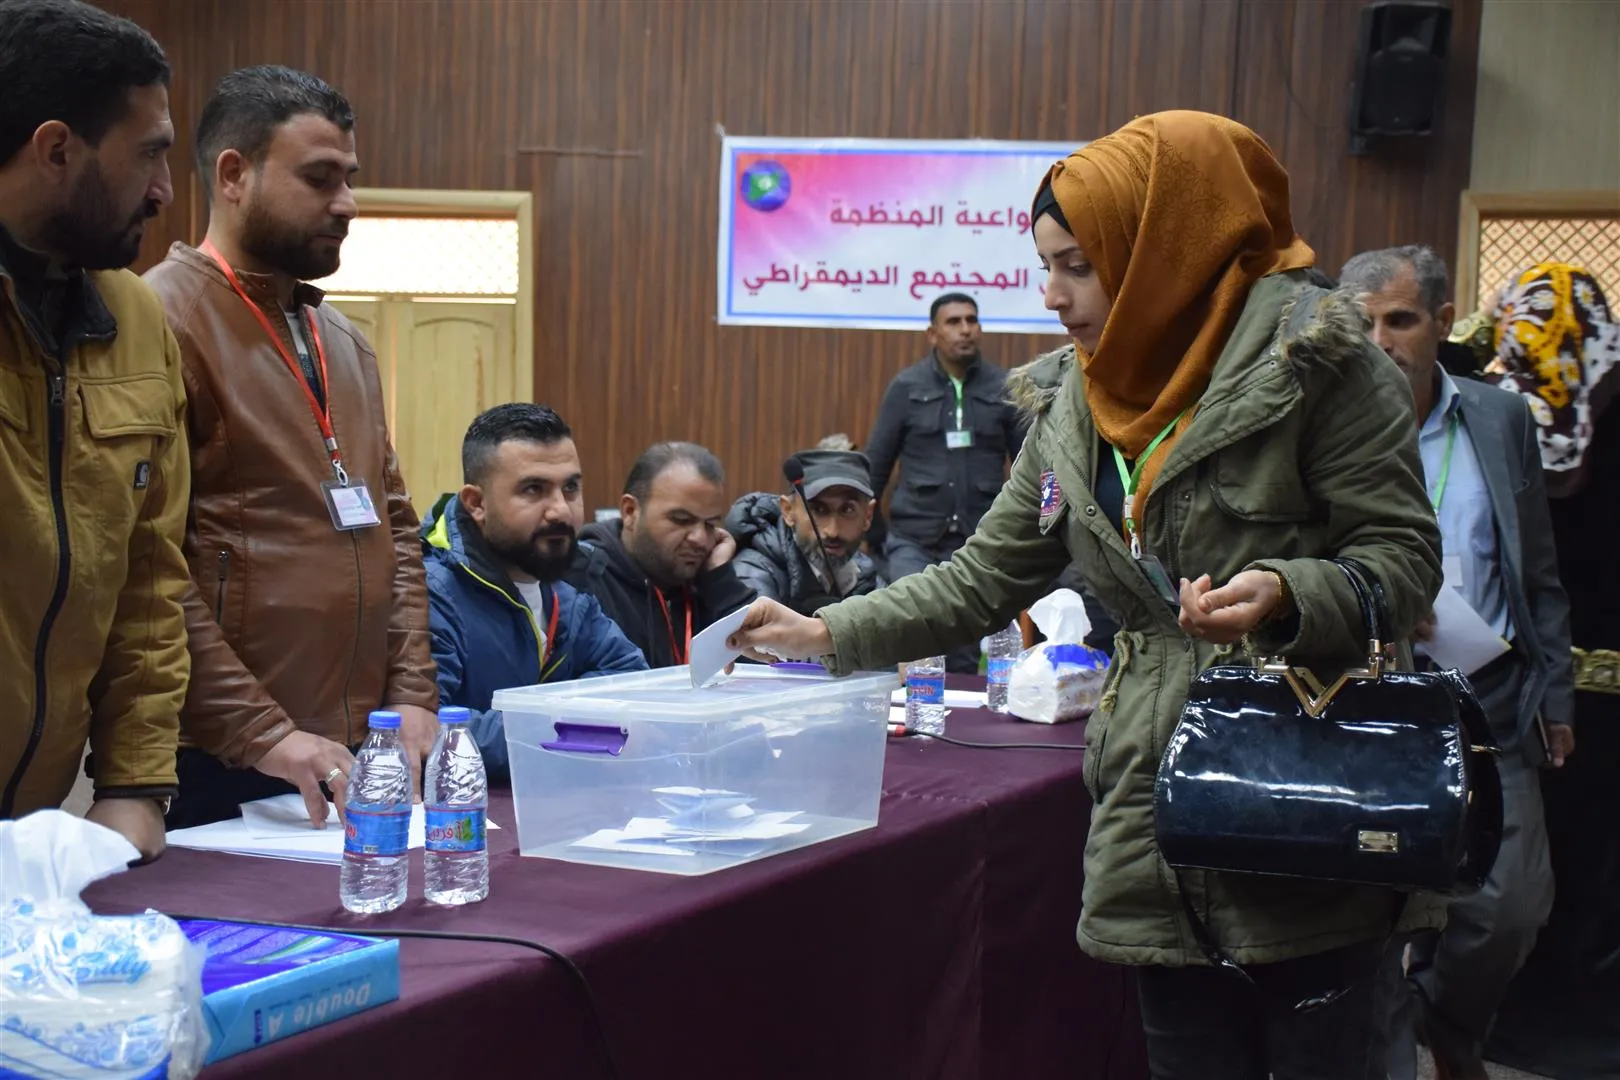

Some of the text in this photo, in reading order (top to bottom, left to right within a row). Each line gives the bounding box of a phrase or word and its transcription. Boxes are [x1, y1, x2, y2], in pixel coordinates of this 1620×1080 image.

[829, 199, 943, 227] المنظمة
[743, 261, 1028, 299] المجتمع الديمقراطي
[294, 982, 371, 1026] Double
[268, 1012, 285, 1039] A
